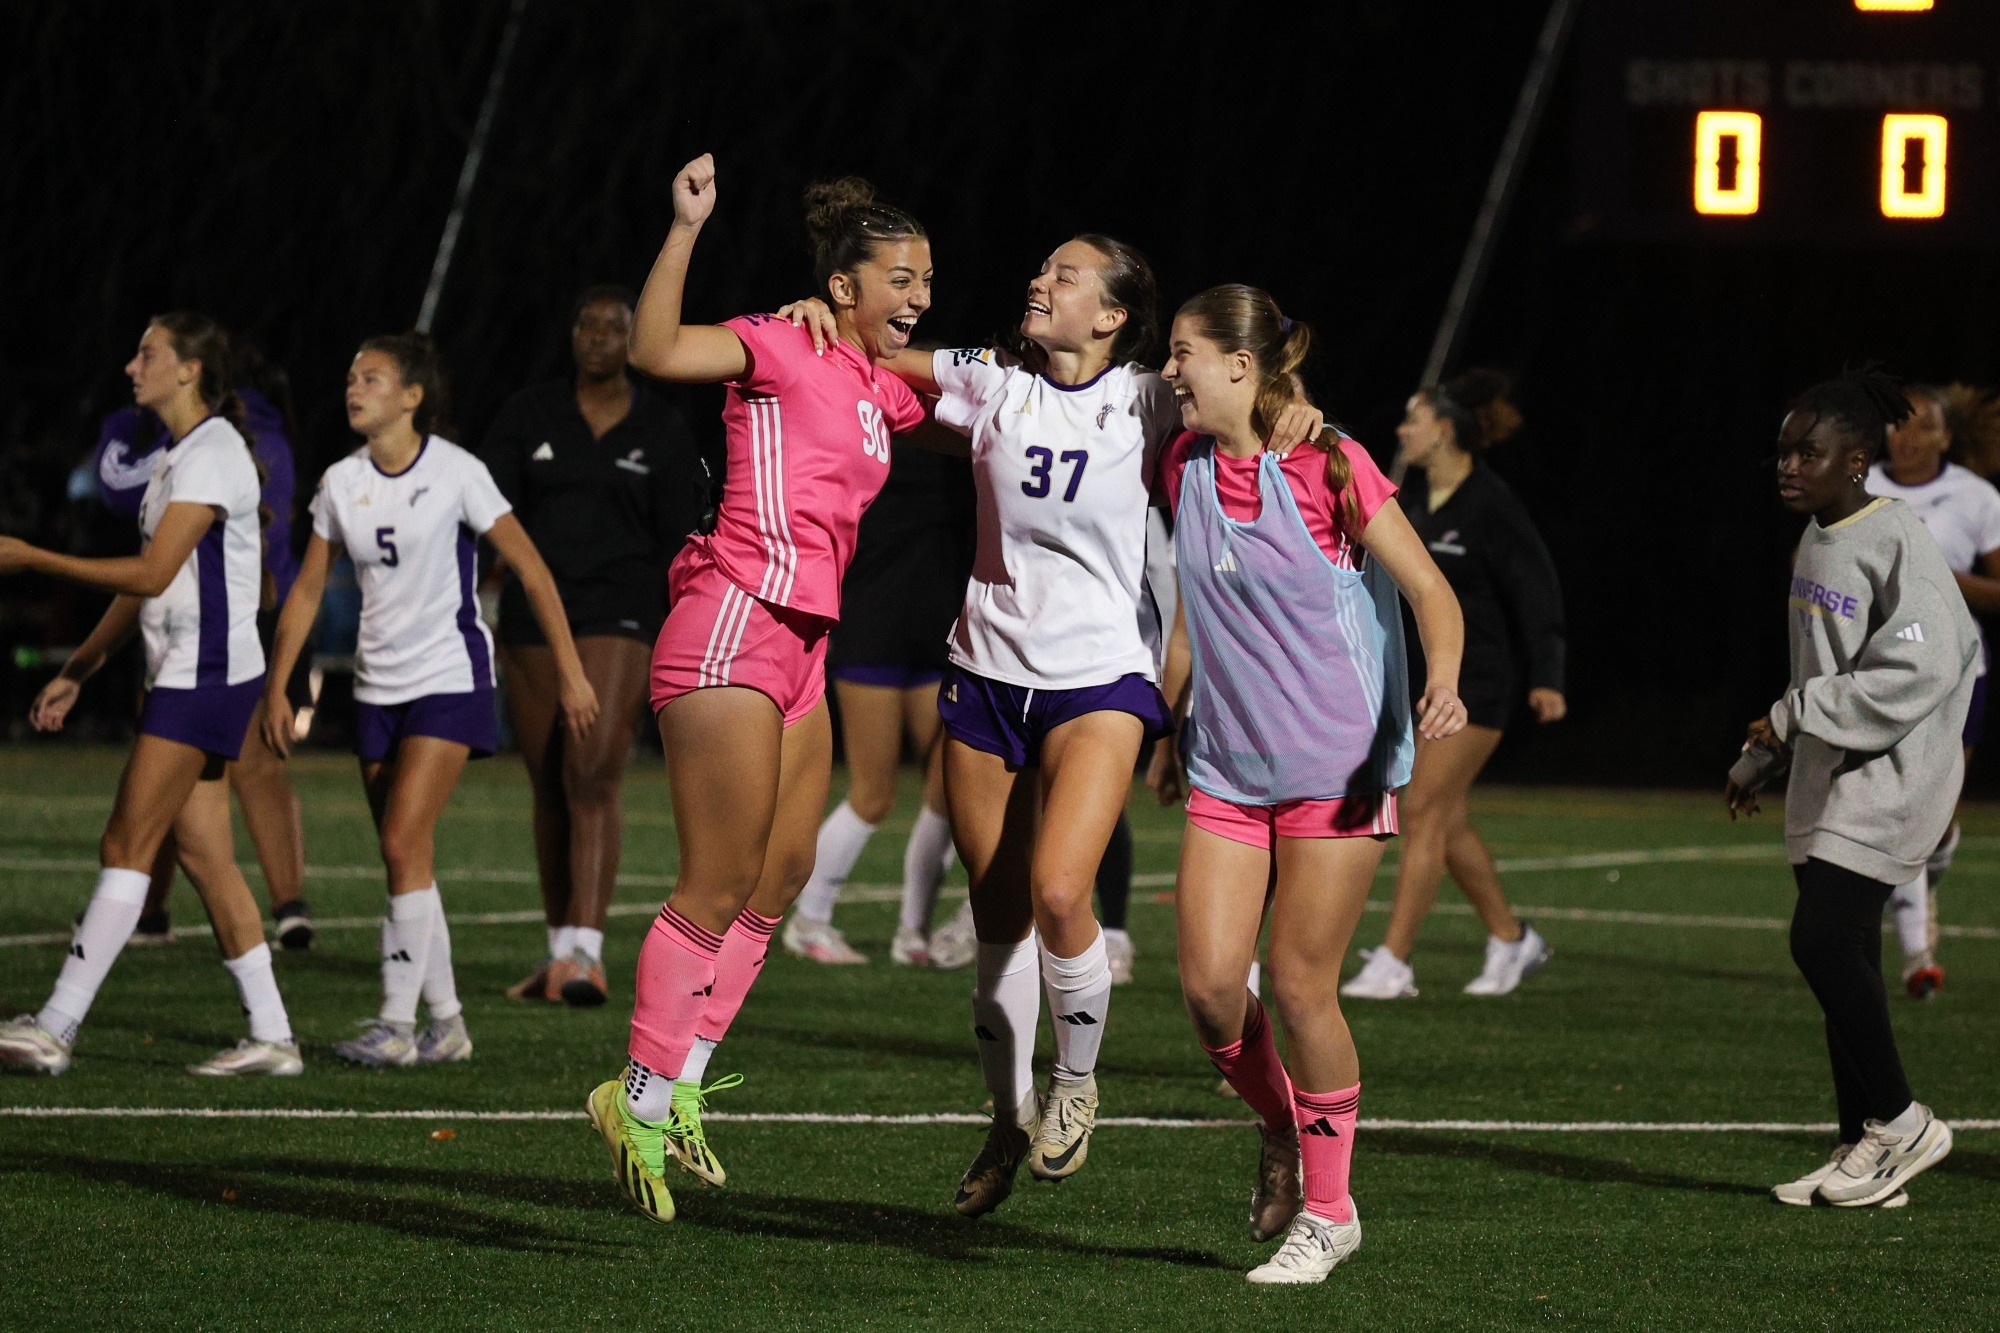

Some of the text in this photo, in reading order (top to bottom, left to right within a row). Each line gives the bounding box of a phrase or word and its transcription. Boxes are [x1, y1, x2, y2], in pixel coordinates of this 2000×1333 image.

[1694, 111, 1761, 214] 0
[1880, 114, 1947, 218] 0
[857, 399, 889, 464] 90
[1021, 445, 1089, 502] 37
[376, 527, 398, 567] 5
